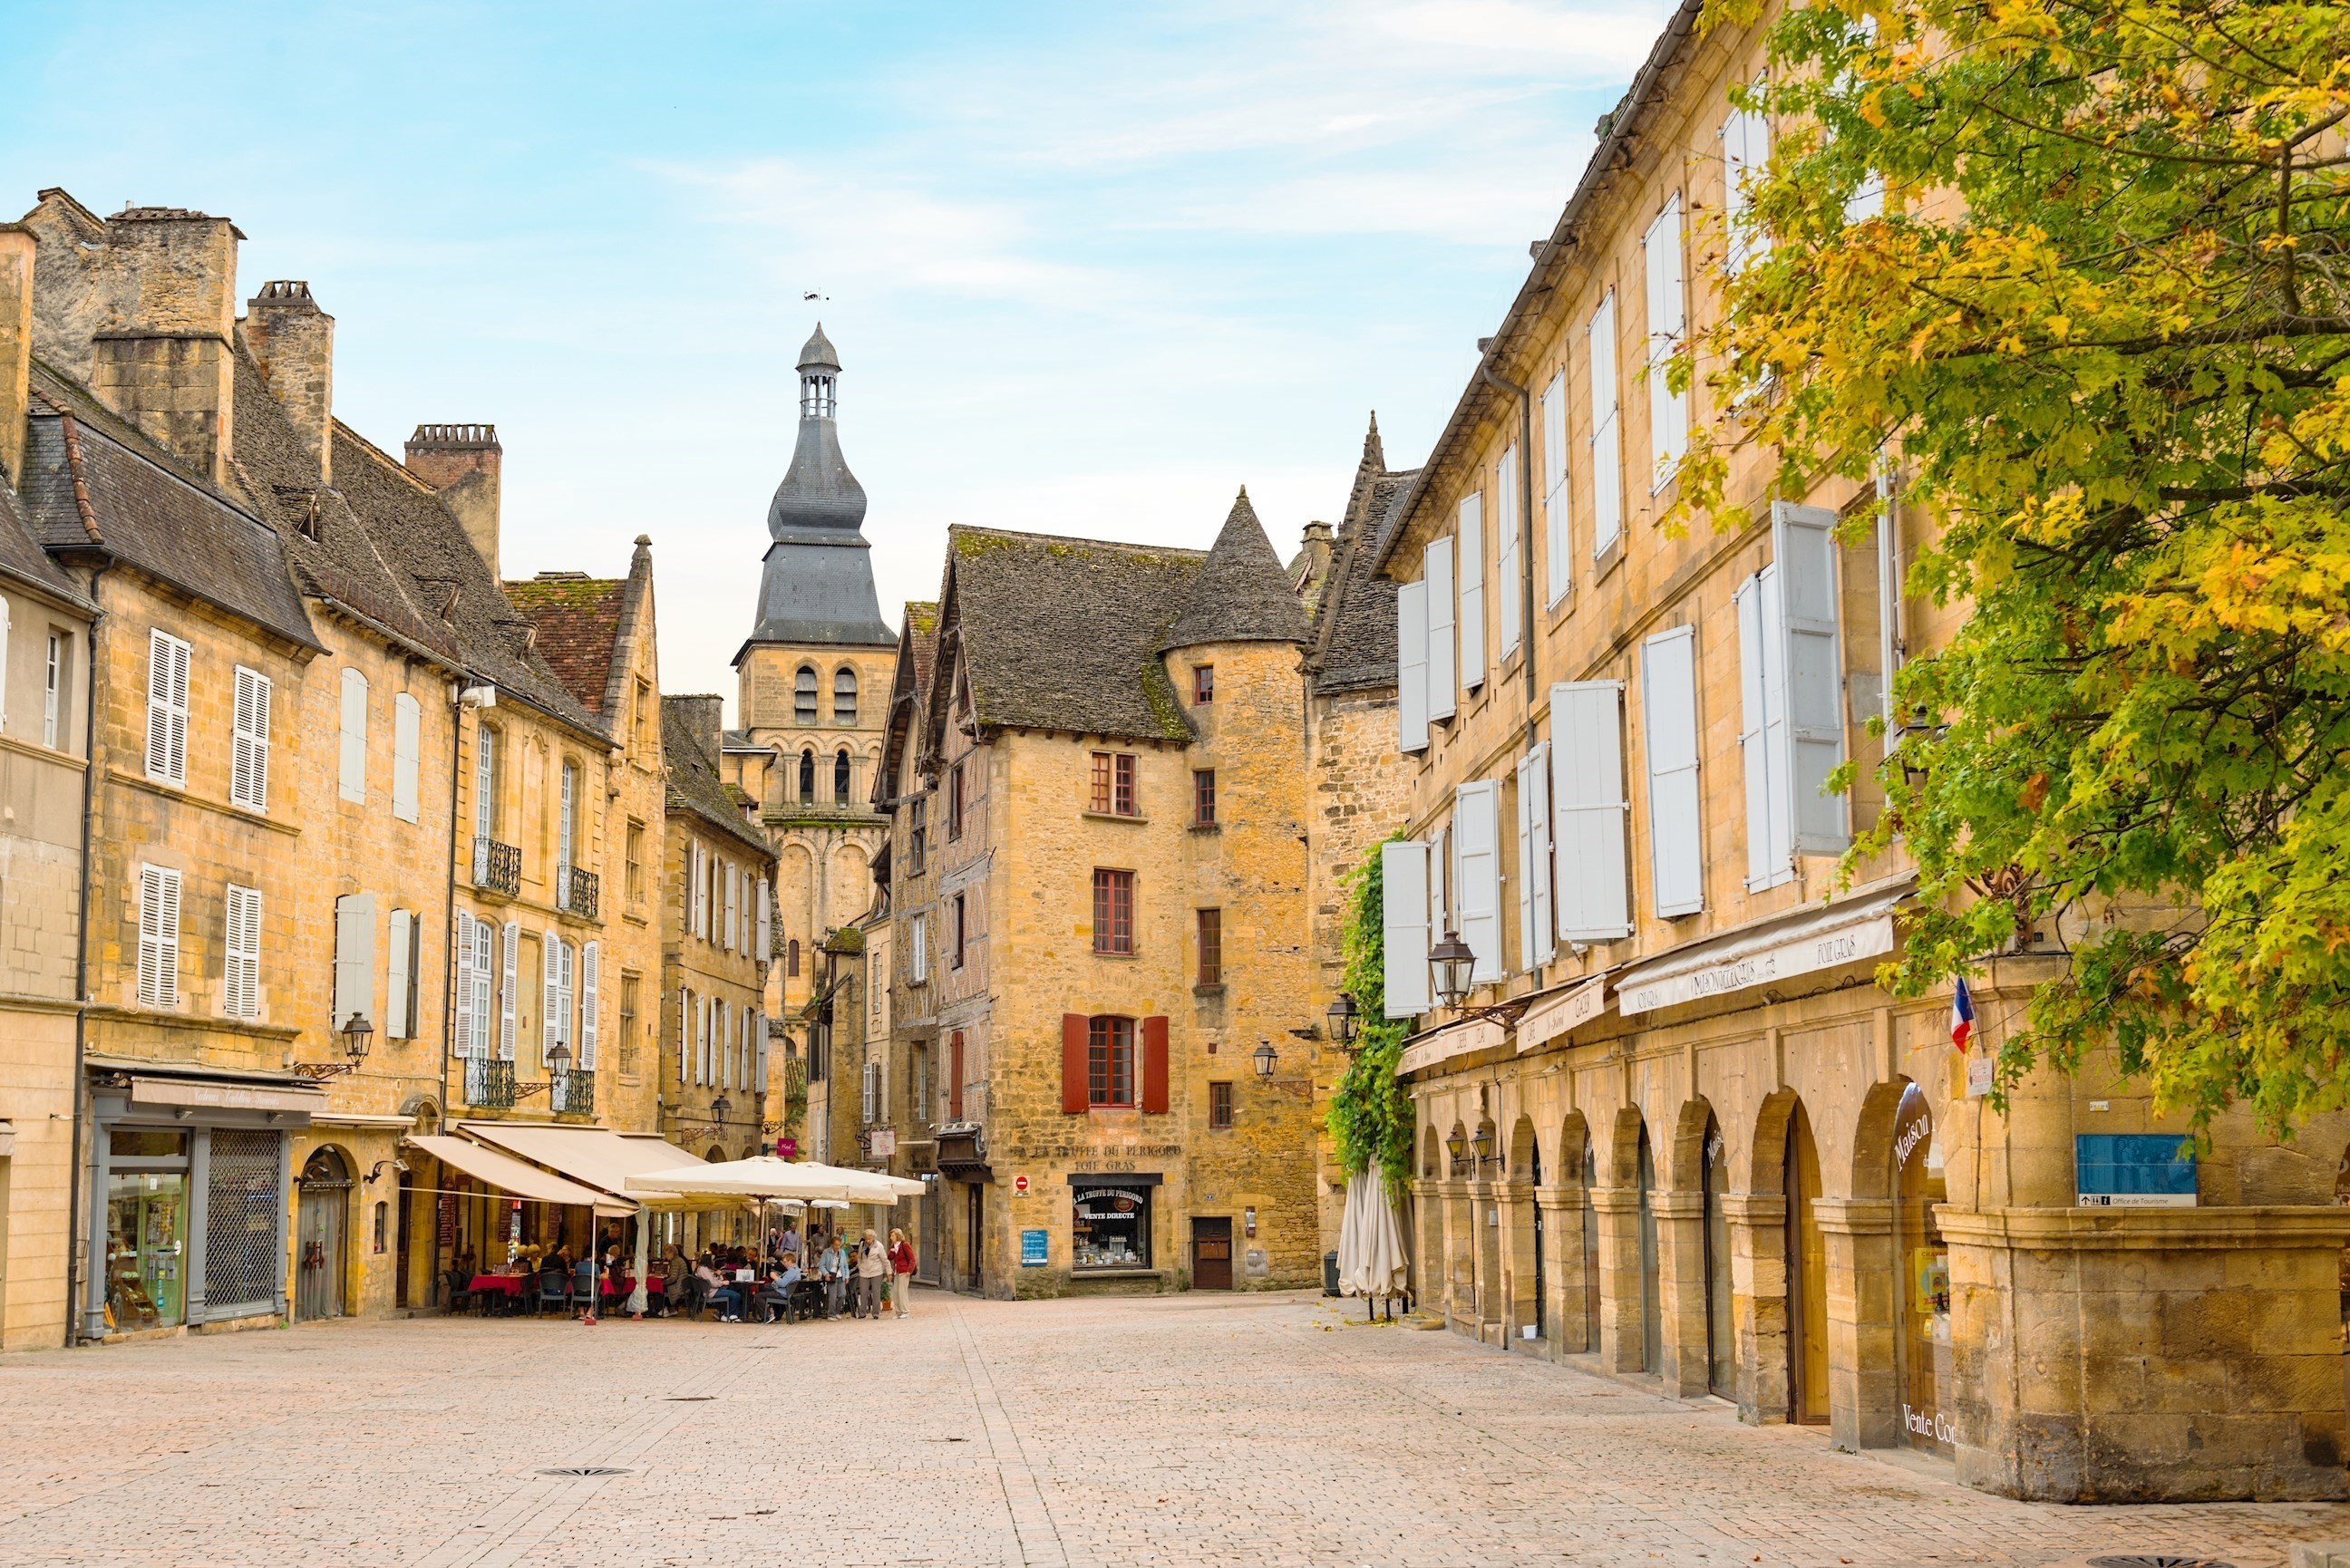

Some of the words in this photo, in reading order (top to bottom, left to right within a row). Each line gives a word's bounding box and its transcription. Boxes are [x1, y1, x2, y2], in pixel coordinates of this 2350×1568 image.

[1818, 942, 1834, 964] FOIE
[1836, 934, 1857, 959] GRAS
[1055, 1146, 1098, 1157] TRUFFE
[1103, 1146, 1119, 1157] DU
[1126, 1146, 1181, 1157] PERIGORD
[1894, 1114, 1929, 1172] Maison
[1074, 1161, 1099, 1171] FOIE
[1106, 1161, 1135, 1171] GRAS
[1077, 1193, 1085, 1202] LA
[1085, 1189, 1107, 1199] TRUFFE
[1115, 1189, 1143, 1205] PERIGORD
[1902, 1403, 1933, 1437] Vente
